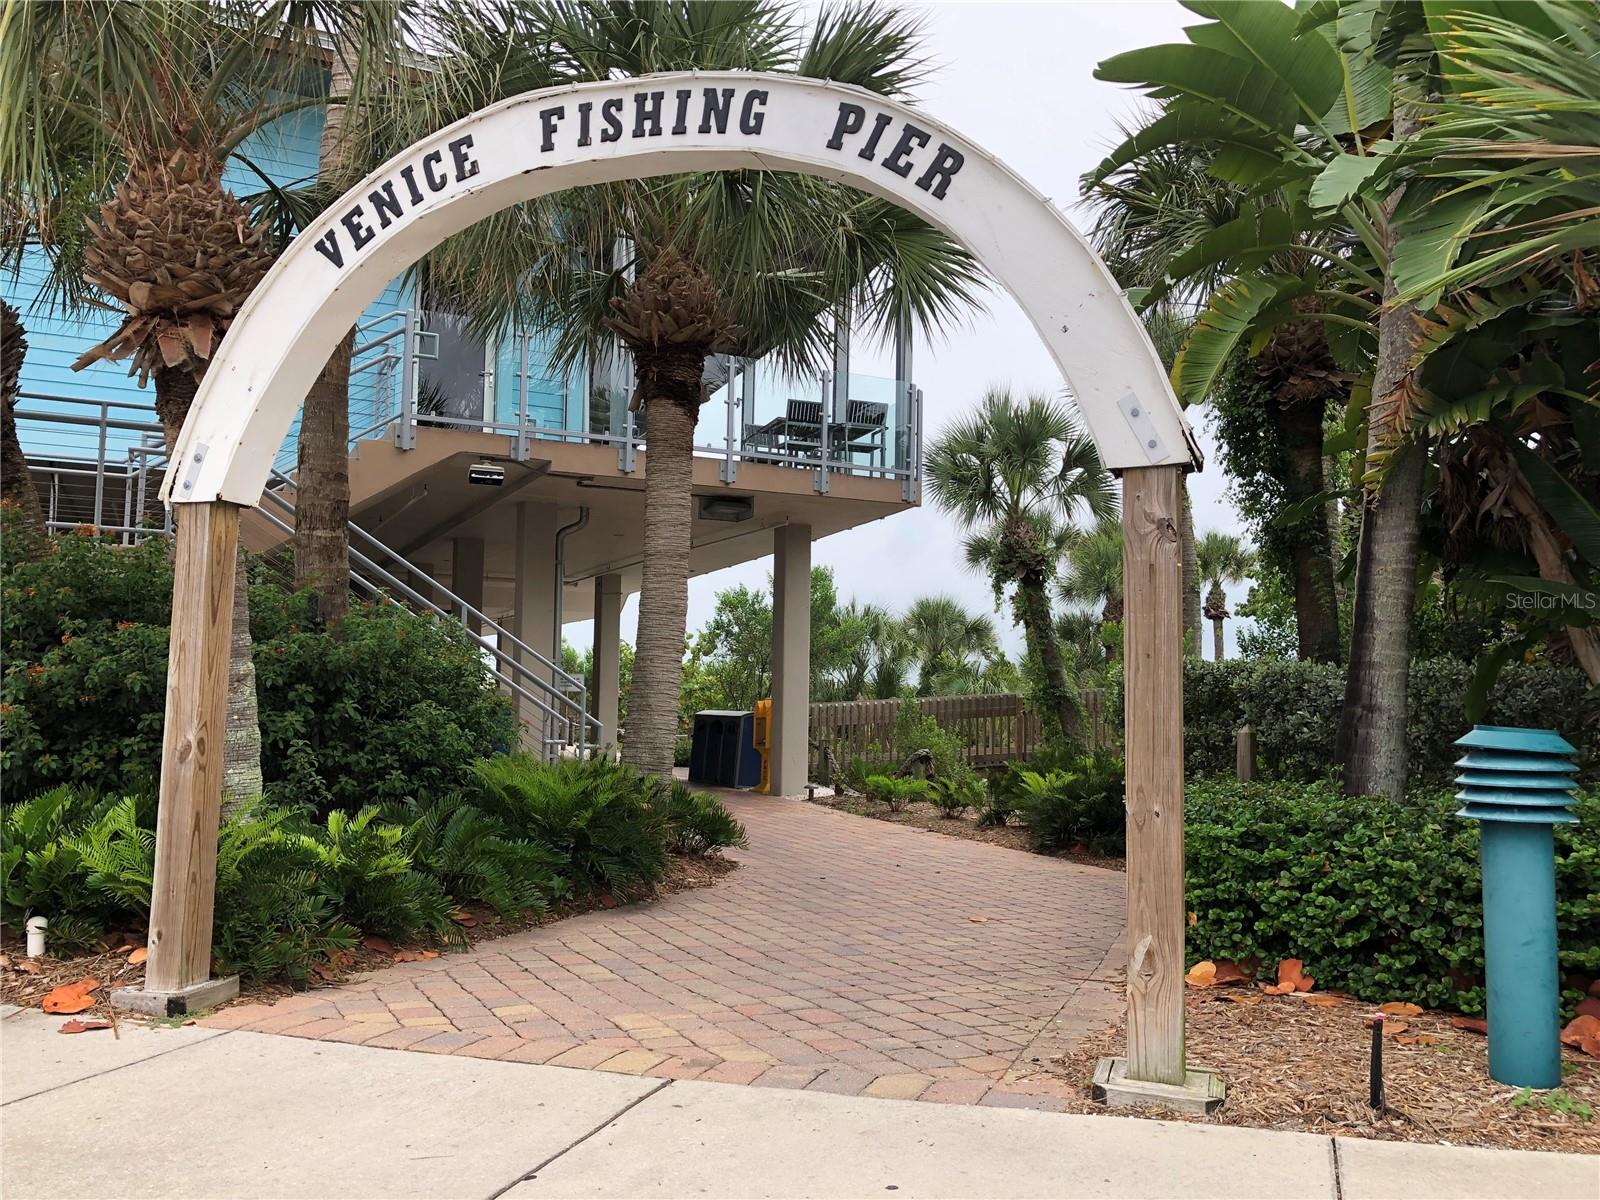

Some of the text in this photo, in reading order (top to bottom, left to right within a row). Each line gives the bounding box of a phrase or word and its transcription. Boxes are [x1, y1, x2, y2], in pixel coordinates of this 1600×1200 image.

[314, 88, 965, 269] VENICE FISHING PIER
